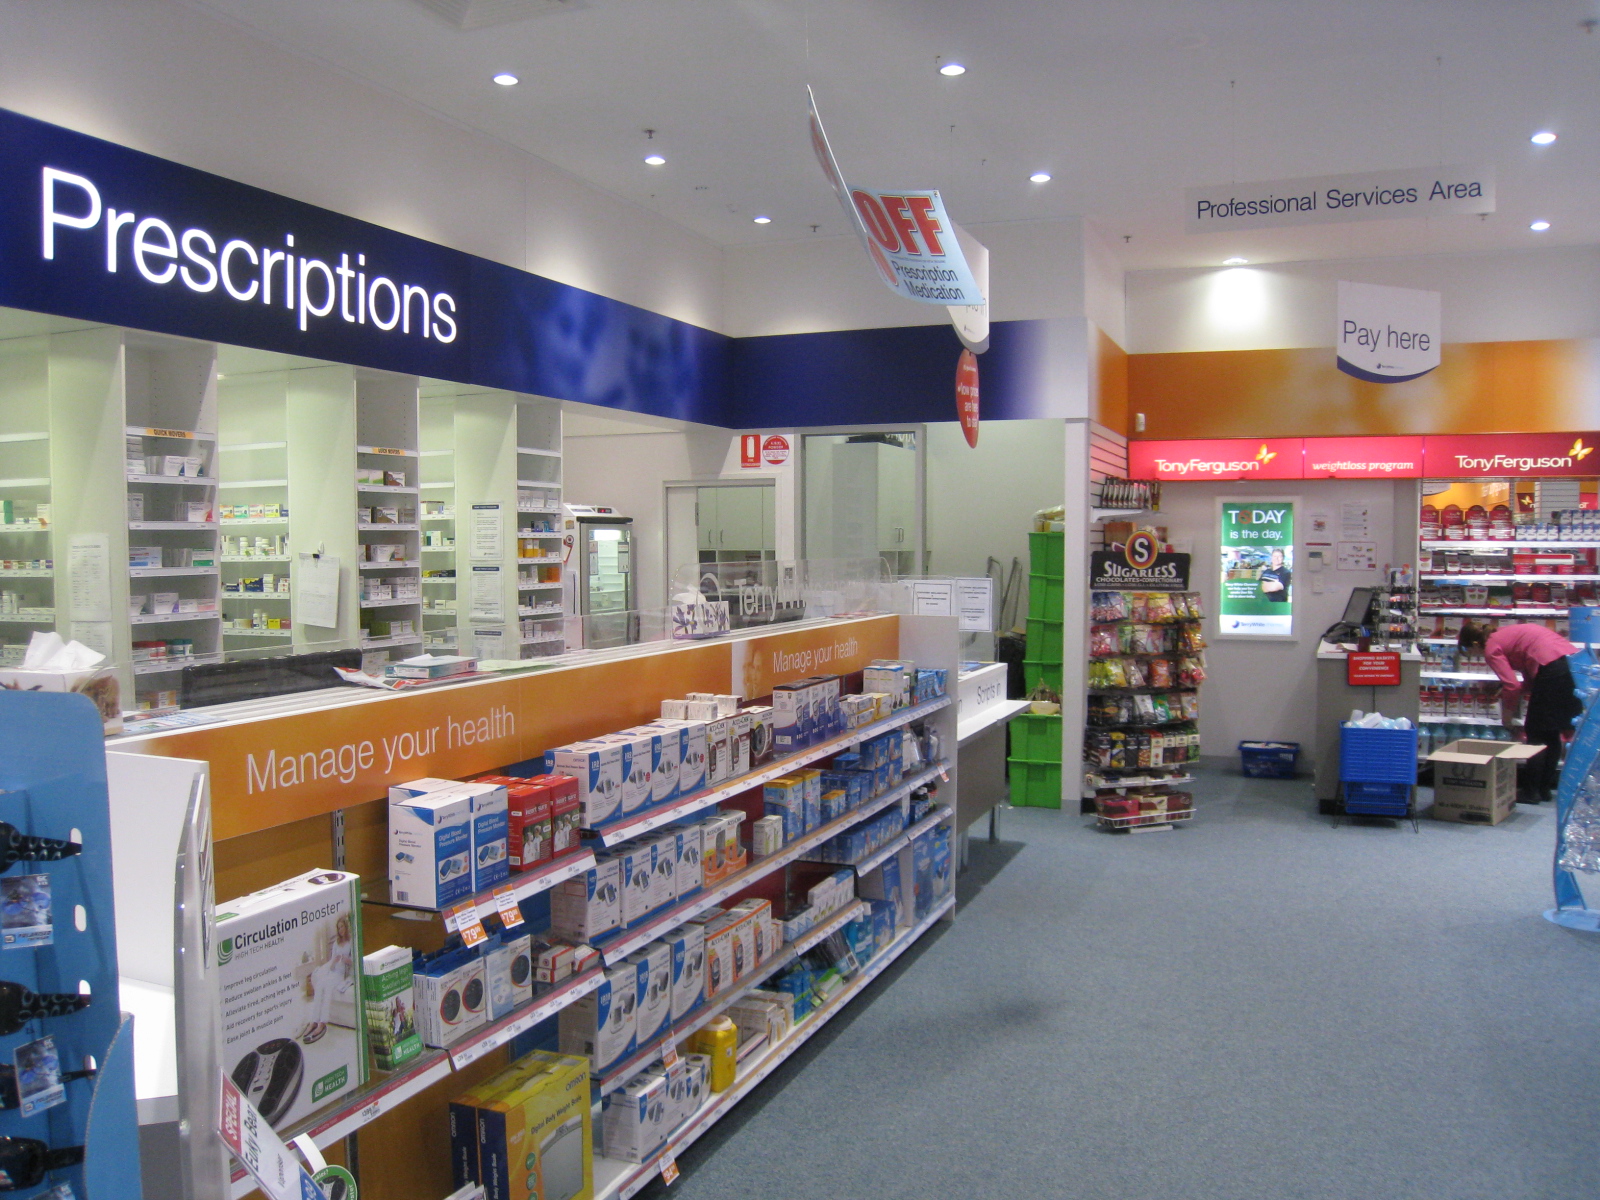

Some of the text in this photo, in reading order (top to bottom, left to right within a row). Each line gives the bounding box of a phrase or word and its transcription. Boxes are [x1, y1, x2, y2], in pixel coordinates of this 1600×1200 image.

[1197, 180, 1482, 219] Professional Services Area
[852, 189, 945, 256] OFF
[43, 166, 457, 343] Prescriptions
[891, 261, 959, 284] Prescription
[904, 280, 966, 300] Medication
[1343, 320, 1430, 352] Pay here
[1154, 458, 1259, 474] TonyFerguson
[1312, 459, 1414, 472] weightloss program
[1455, 454, 1572, 472] TonyFerguson
[1230, 530, 1283, 540] is the day.
[1134, 538, 1148, 562] S
[1104, 561, 1176, 578] SUGARLESS
[773, 637, 858, 673] Manage your health
[978, 684, 996, 705] Scripts
[247, 704, 516, 795] Manage your health
[235, 903, 340, 950] Circulation Booster
[235, 936, 285, 960] HIGH TECH HEALTH
[224, 978, 244, 991] Improve
[253, 966, 277, 979] circulation
[225, 993, 242, 1004] Reduce
[244, 985, 262, 996] swollen
[263, 978, 278, 989] ankles
[283, 972, 292, 981] feet
[226, 1003, 246, 1017] Alleviate
[260, 992, 276, 1005] aching
[277, 988, 286, 997] legs
[226, 1022, 234, 1030] Aid
[235, 1014, 255, 1028] recovery
[264, 1004, 279, 1016] sports
[280, 998, 292, 1009] injury
[227, 1036, 239, 1044] Ease
[239, 1029, 250, 1039] joint
[256, 1021, 273, 1032] muscle
[274, 1015, 284, 1024] pain
[404, 1043, 420, 1054] HEALTH
[324, 1076, 345, 1090] HEALTH
[225, 1089, 237, 1140] SPECIAL
[244, 1104, 258, 1138] Bear
[531, 1096, 582, 1135] Digital Body Weight Scale
